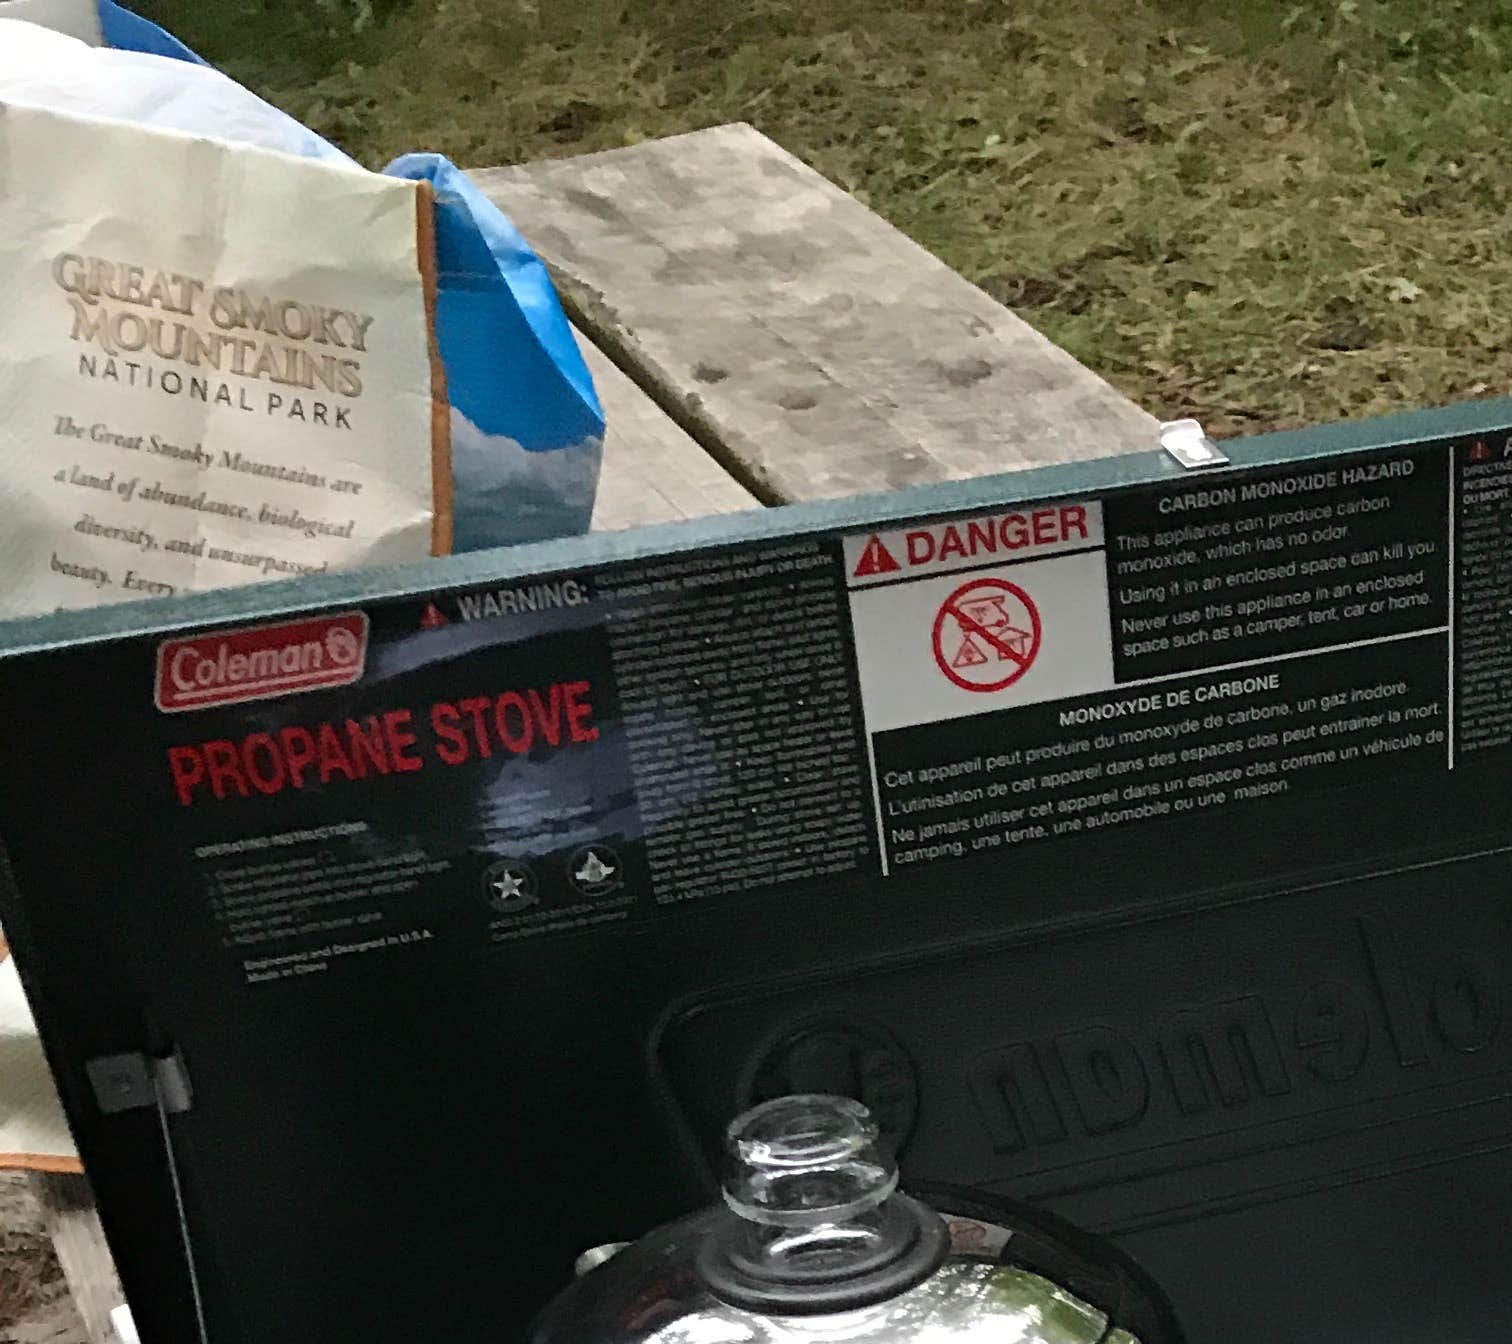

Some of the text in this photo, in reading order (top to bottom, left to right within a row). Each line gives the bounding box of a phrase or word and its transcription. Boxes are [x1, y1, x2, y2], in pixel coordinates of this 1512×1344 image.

[52, 252, 374, 353] GREAT SMOKY
[67, 301, 363, 398] MOUNTAINS
[78, 353, 353, 430] NATIONAL PARK
[52, 414, 363, 496] The Great Smoky Mountains are
[1158, 459, 1414, 515] CARBON MONOXIDE HAZARD
[69, 465, 114, 493] land
[117, 477, 140, 498] of
[138, 481, 252, 524] abundance,
[258, 502, 356, 540] biological
[905, 504, 1089, 567] DANGER
[1115, 496, 1391, 552] This appliance can produce carbon
[73, 514, 158, 553] diversity,
[164, 536, 207, 558] and
[1117, 526, 1351, 575] monoxide, which has no odor.
[456, 579, 590, 621] WARNING:
[1118, 586, 1166, 606] Using
[1169, 580, 1180, 598] it
[1183, 578, 1199, 595] in
[1202, 577, 1222, 592] an
[1225, 561, 1297, 589] enclosed
[1299, 556, 1347, 578] space
[1350, 551, 1379, 568] can
[1382, 543, 1404, 563] kill
[1120, 569, 1424, 635] Never use this appliance in an enclosed
[1122, 635, 1169, 657] space
[1172, 625, 1208, 647] such
[1211, 625, 1230, 640] as
[1232, 623, 1243, 637] a
[1245, 614, 1303, 635] camper,
[1343, 602, 1368, 619] car
[1368, 599, 1386, 615] or
[1387, 593, 1433, 611] home.
[170, 639, 325, 692] Coleman
[1058, 672, 1280, 727] MONOXYDE DE CARBONE
[167, 680, 600, 807] PROPANE STOVE
[883, 683, 1409, 789] Cet appareil peut produire du monoxyde de carbone, un gaz inodore.
[986, 782, 1008, 800] de
[1011, 775, 1037, 795] cet
[1039, 763, 1102, 792] appareil
[1104, 759, 1144, 778] dans
[1147, 753, 1177, 770] des
[1179, 741, 1244, 765] espaces
[1246, 734, 1278, 753] clos
[1282, 724, 1317, 750] peut
[1387, 710, 1401, 727] la
[891, 727, 1445, 844] Ne jamais utiliser cet appareil dans un espace clos comme un véhicule de
[893, 840, 967, 864] camping,
[970, 832, 1001, 850] une
[1053, 817, 1082, 835] une
[1085, 800, 1170, 829] automobile
[1173, 797, 1194, 813] ou
[1196, 791, 1227, 808] une
[1233, 780, 1291, 802] maison.
